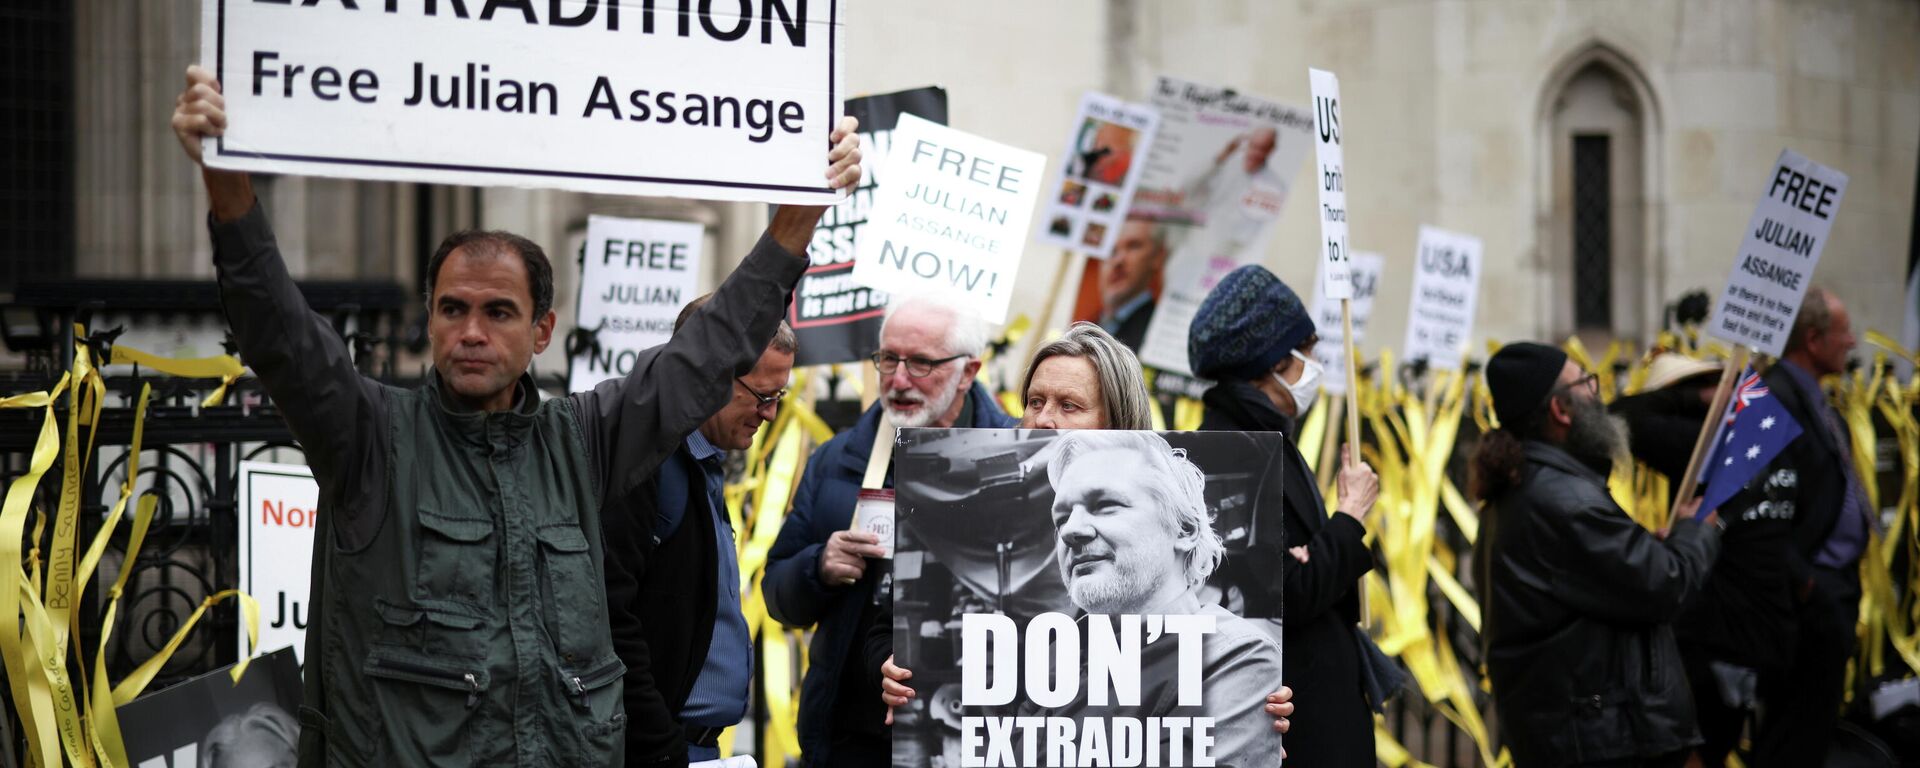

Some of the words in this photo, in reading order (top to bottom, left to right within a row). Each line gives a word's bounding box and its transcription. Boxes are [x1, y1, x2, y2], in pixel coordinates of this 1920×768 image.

[251, 50, 380, 103] Free
[403, 61, 559, 116] Julian
[582, 75, 805, 143] Assange
[912, 138, 1024, 194] FREE
[905, 183, 1008, 226] JULIAN
[1769, 166, 1838, 220] FREE
[602, 237, 688, 272] FREE
[896, 212, 1001, 254] ASSANGE
[1327, 236, 1340, 262] to
[1754, 217, 1815, 259] JULIAN
[878, 239, 998, 297] NOW!
[1422, 243, 1471, 280] USA
[1740, 253, 1803, 292] ASSANGE
[601, 283, 681, 306] JULIAN
[49, 547, 73, 609] Benny
[961, 612, 1217, 708] DON'T
[48, 656, 72, 712] Canada
[961, 716, 1216, 768] EXTRADITE
